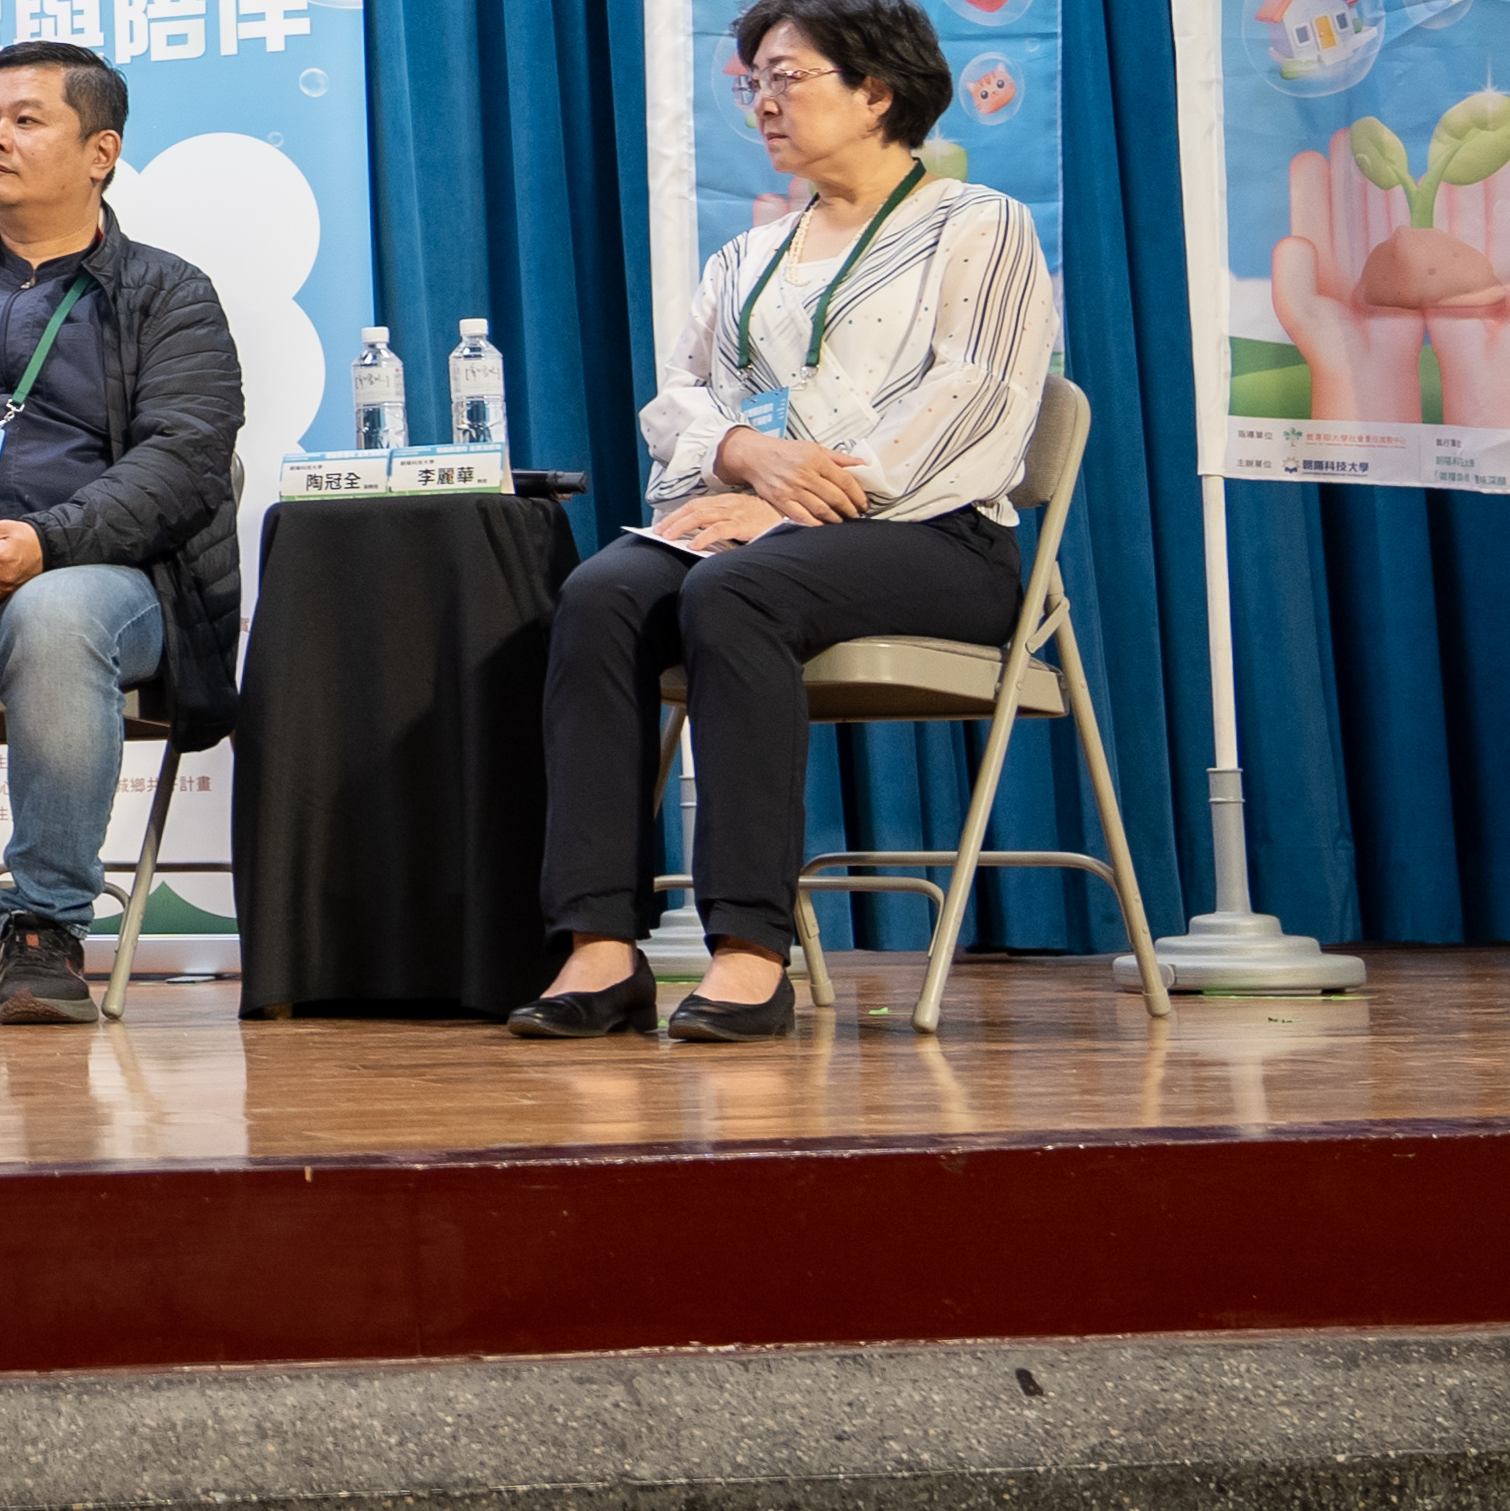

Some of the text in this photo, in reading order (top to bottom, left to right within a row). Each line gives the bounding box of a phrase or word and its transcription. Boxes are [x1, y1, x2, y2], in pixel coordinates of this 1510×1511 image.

[306, 472, 362, 491] 陶冠全
[418, 466, 475, 486] 李麗華
